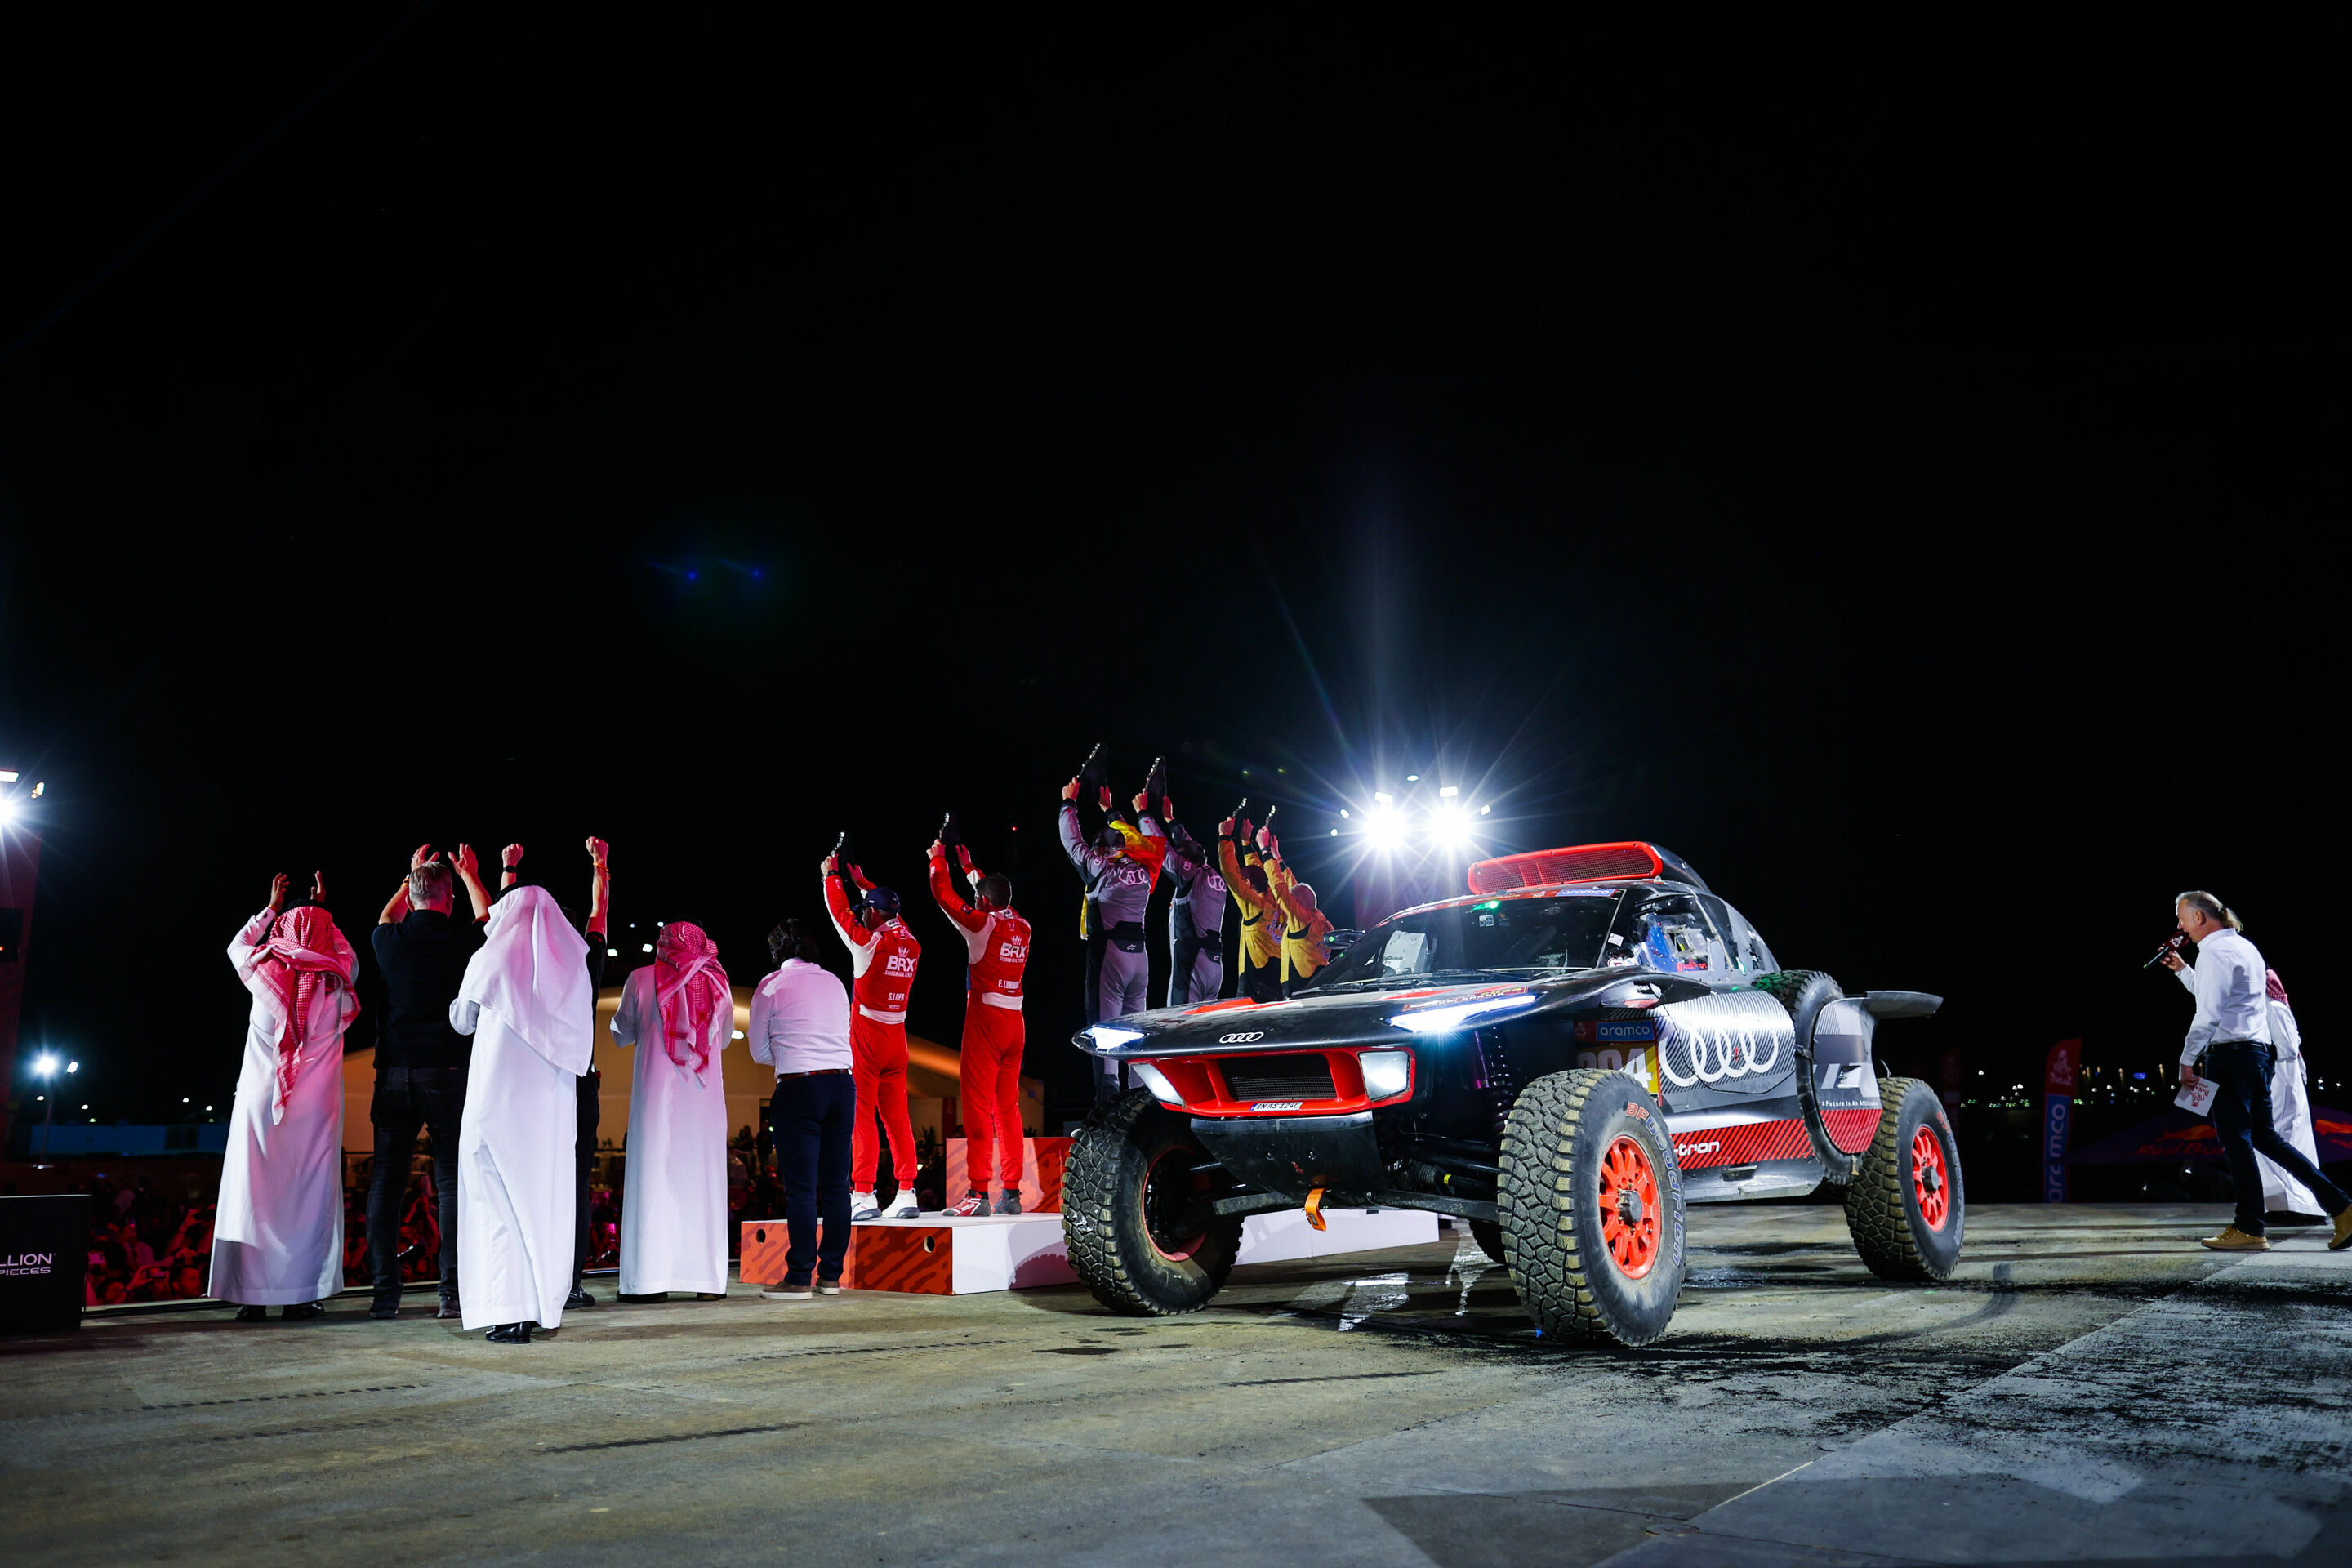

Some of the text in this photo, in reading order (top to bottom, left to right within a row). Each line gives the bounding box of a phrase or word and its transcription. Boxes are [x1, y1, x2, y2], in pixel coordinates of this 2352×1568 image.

[1000, 942, 1027, 958] BRX
[886, 955, 916, 972] BRX
[1600, 1026, 1650, 1036] aramco
[1673, 1141, 1720, 1156] -tron
